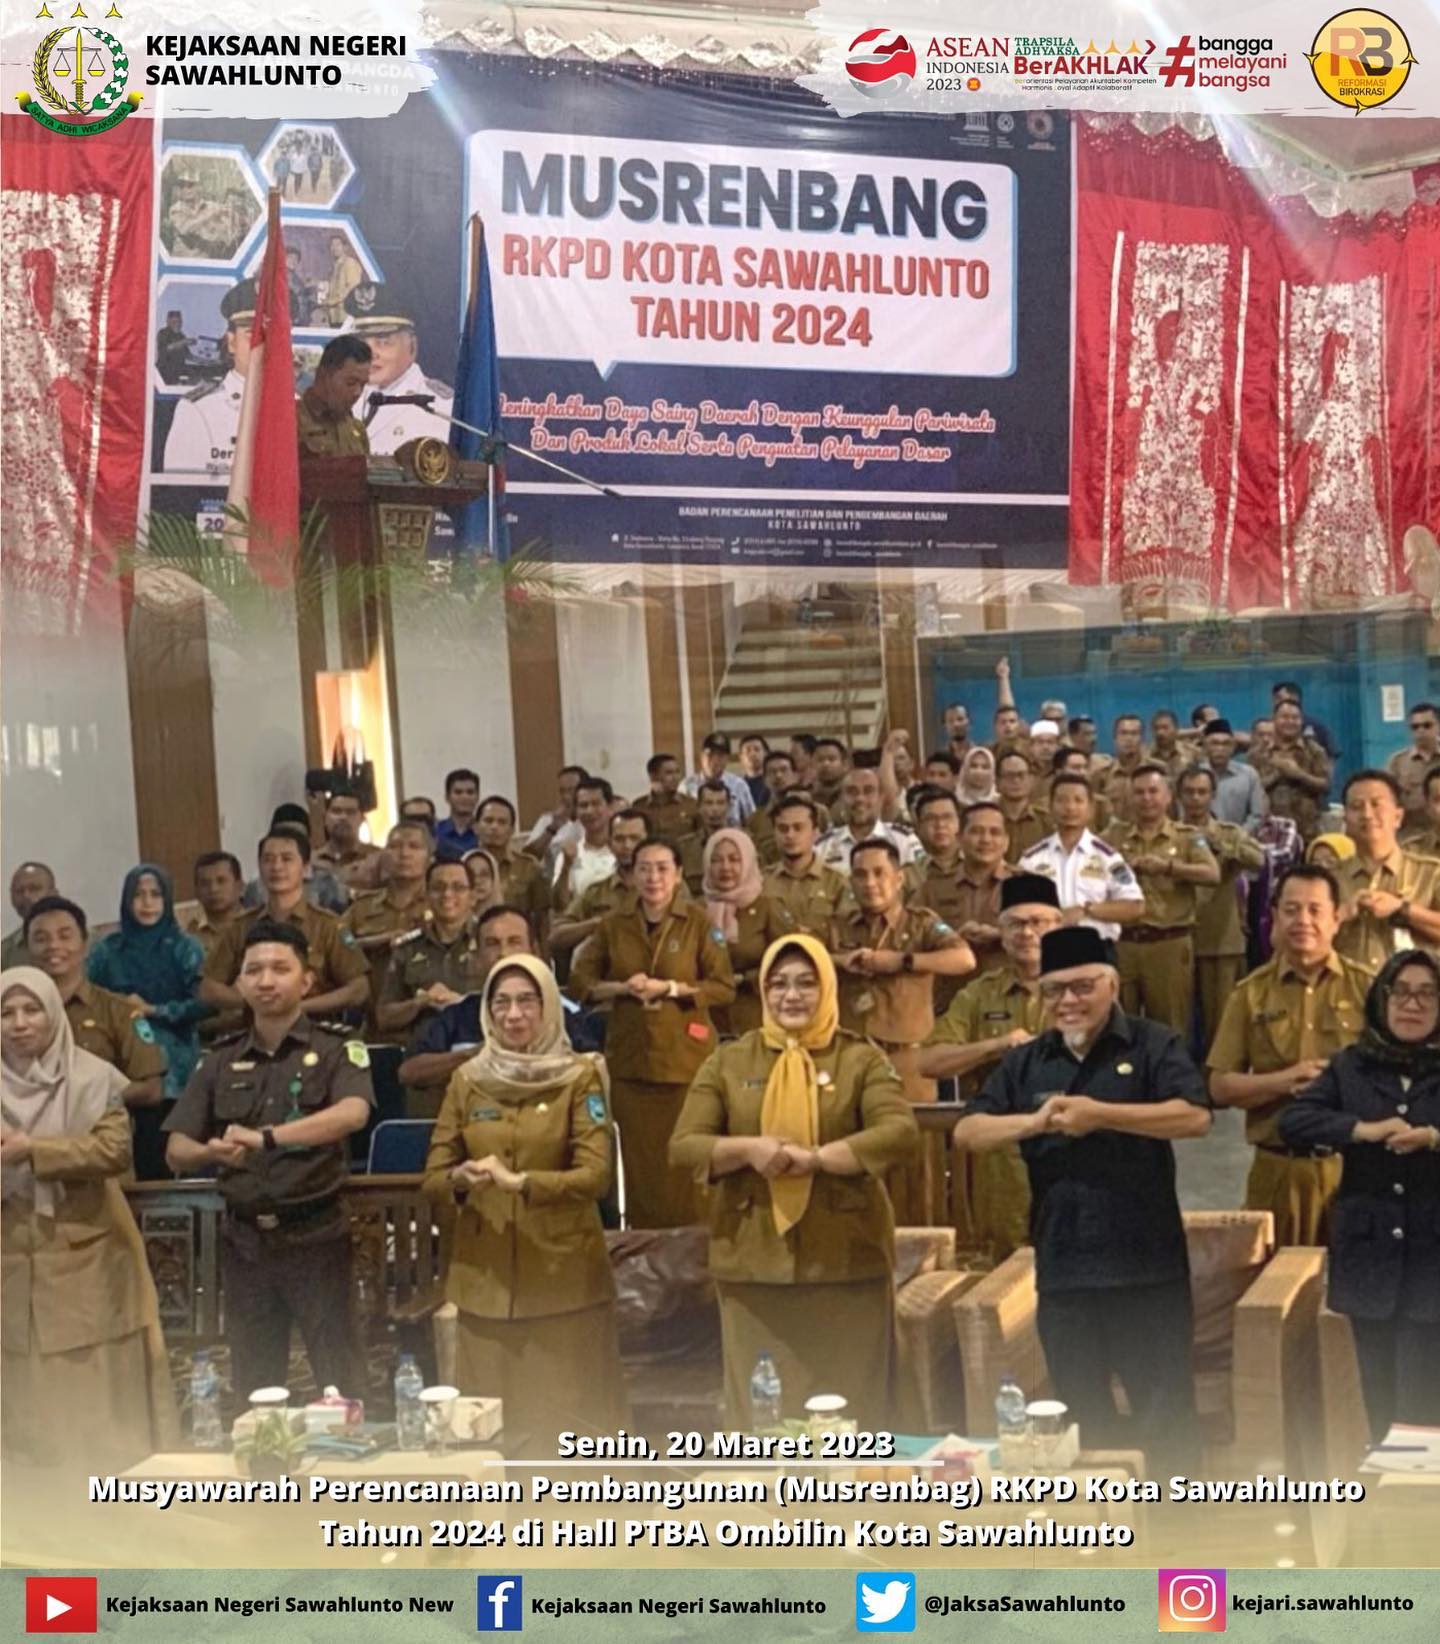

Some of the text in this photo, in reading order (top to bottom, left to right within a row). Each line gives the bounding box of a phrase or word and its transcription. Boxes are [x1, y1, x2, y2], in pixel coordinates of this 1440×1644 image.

[501, 150, 989, 241] MUSRENBANG
[503, 234, 989, 299] RKPD KOTA SAWAHLUNTO
[631, 297, 872, 347] TAHUN 2024
[604, 396, 649, 431] Daya
[651, 398, 698, 432] Saing
[701, 400, 759, 426] Daerah
[762, 402, 821, 436] Dengan
[823, 404, 912, 439] Keunggulan
[915, 408, 996, 432] Pariwisata
[211, 447, 235, 459] Der
[531, 426, 951, 469] Dan Produk Lokal Serta Penguatan Pelayanan Dasar
[679, 506, 709, 517] BADAN
[768, 520, 861, 531] KOTA SAWAHLUNTO
